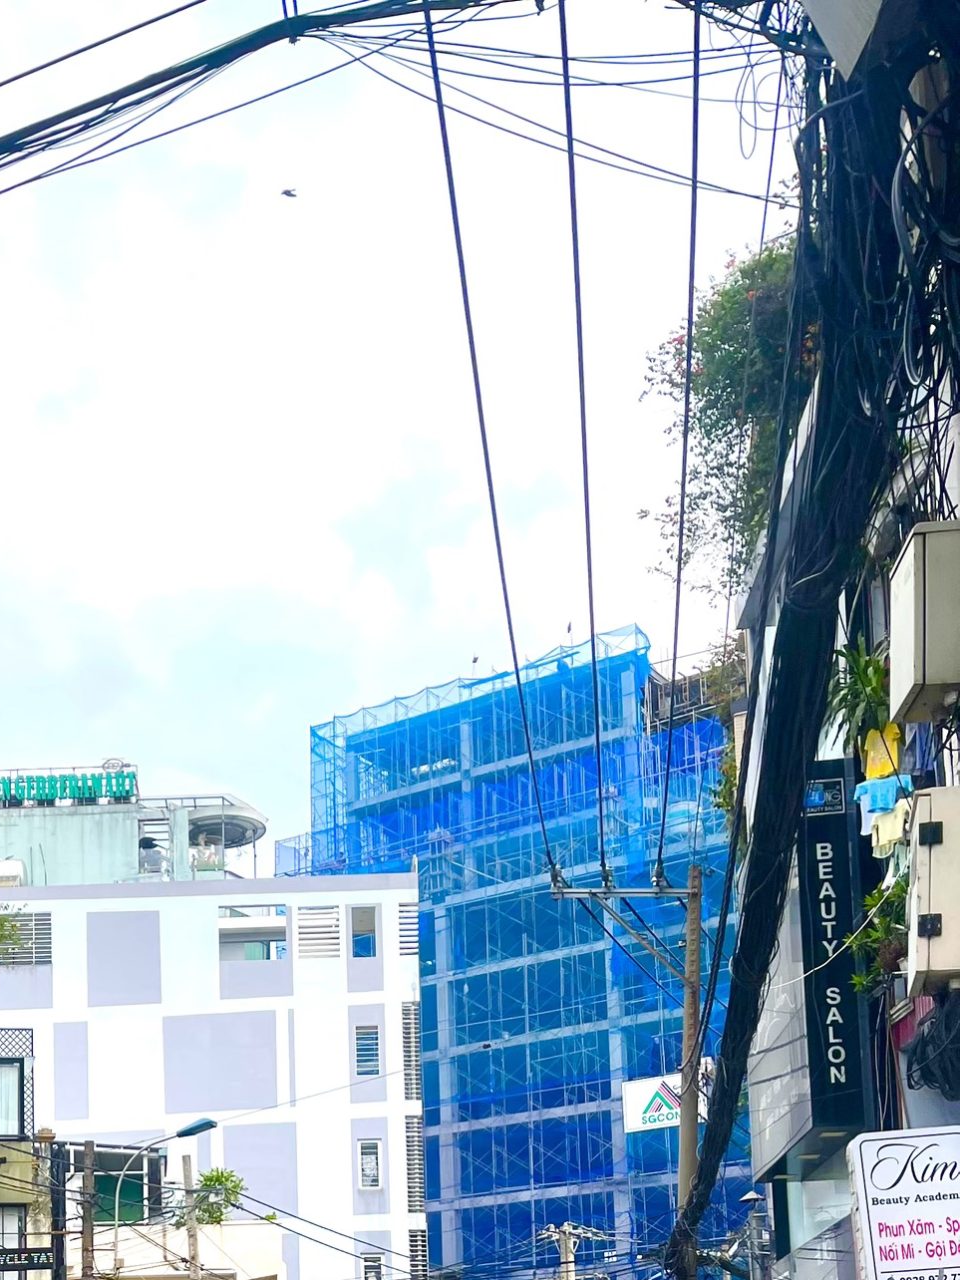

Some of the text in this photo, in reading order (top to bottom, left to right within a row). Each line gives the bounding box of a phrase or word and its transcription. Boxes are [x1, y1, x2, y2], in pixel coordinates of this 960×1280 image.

[815, 842, 838, 958] BEAUTY
[826, 987, 846, 1084] SALON
[872, 1191, 960, 1206] Beauty Academ
[878, 1222, 905, 1238] Phun
[946, 1216, 960, 1236] Sp
[879, 1242, 899, 1262] Nối
[901, 1243, 915, 1260] Mi
[926, 1241, 946, 1260] Gội
